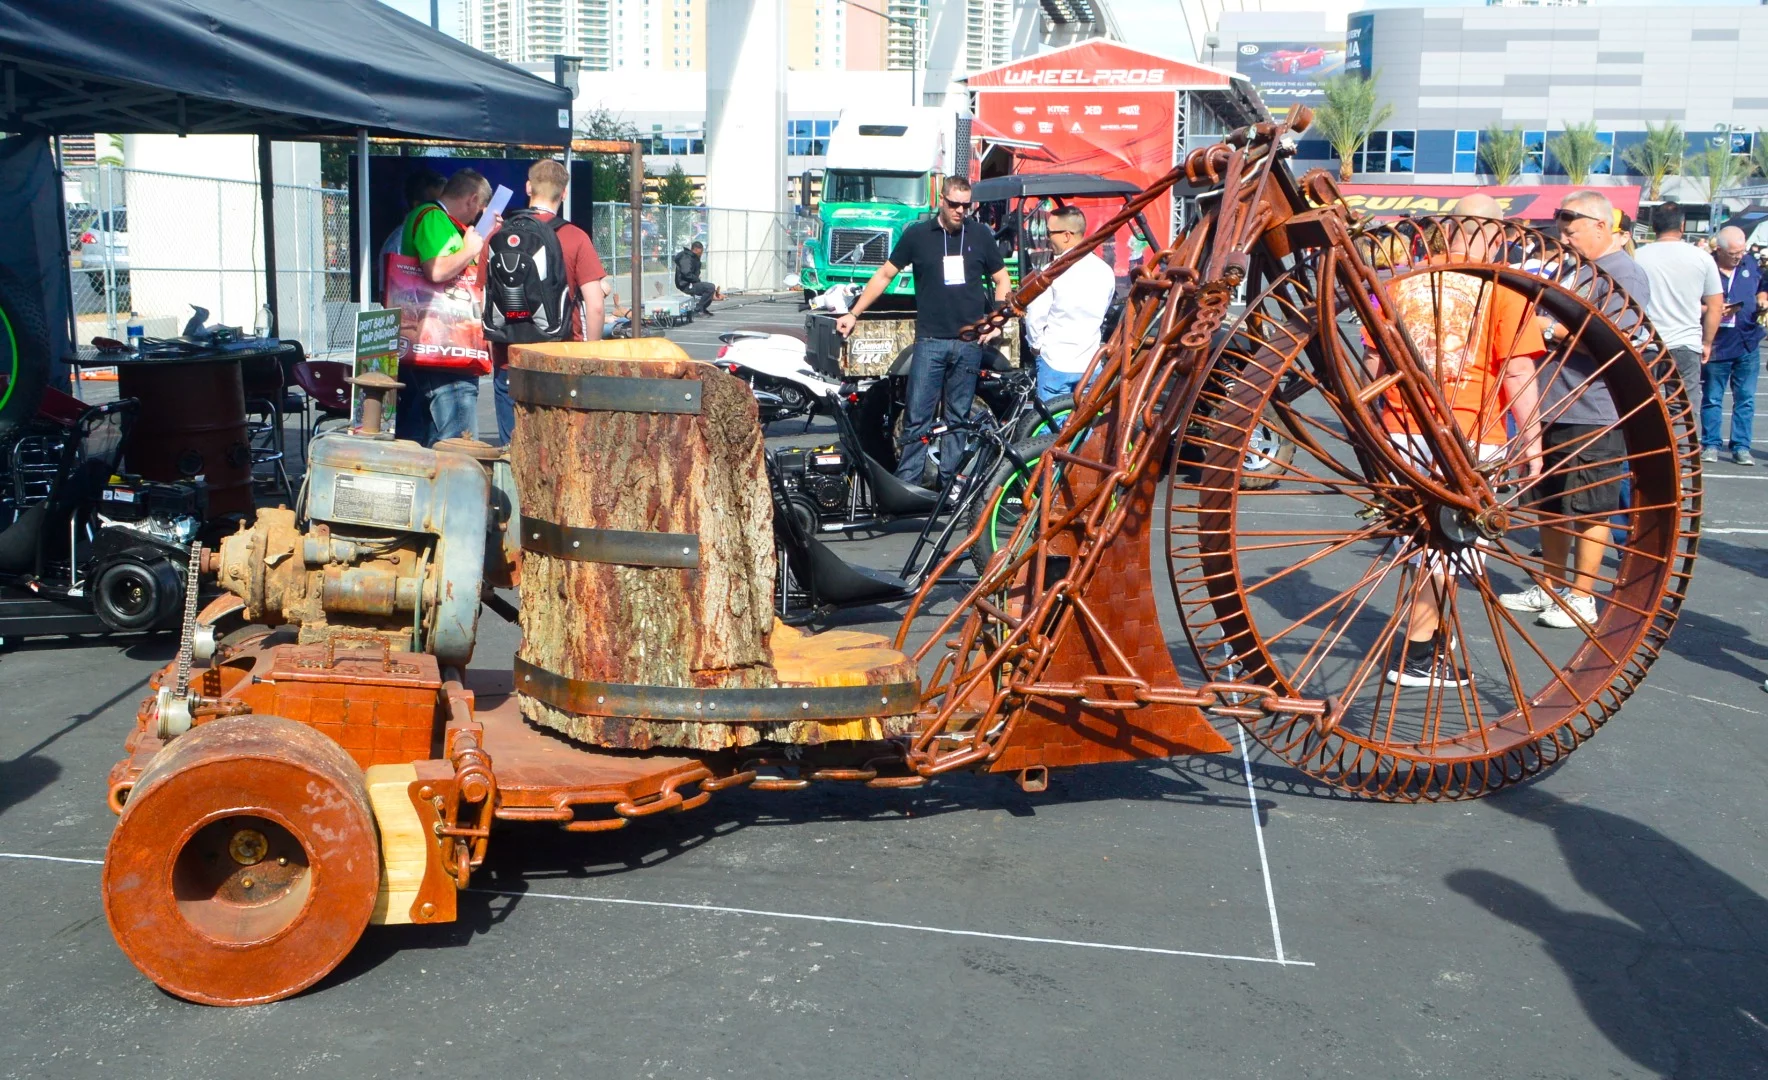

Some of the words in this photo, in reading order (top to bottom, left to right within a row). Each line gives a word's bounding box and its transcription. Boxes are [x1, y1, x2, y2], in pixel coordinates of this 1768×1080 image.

[1004, 69, 1091, 84] WHEEL
[1093, 69, 1165, 84] PROS
[412, 344, 490, 361] SPYDER
[855, 341, 885, 351] Coleman
